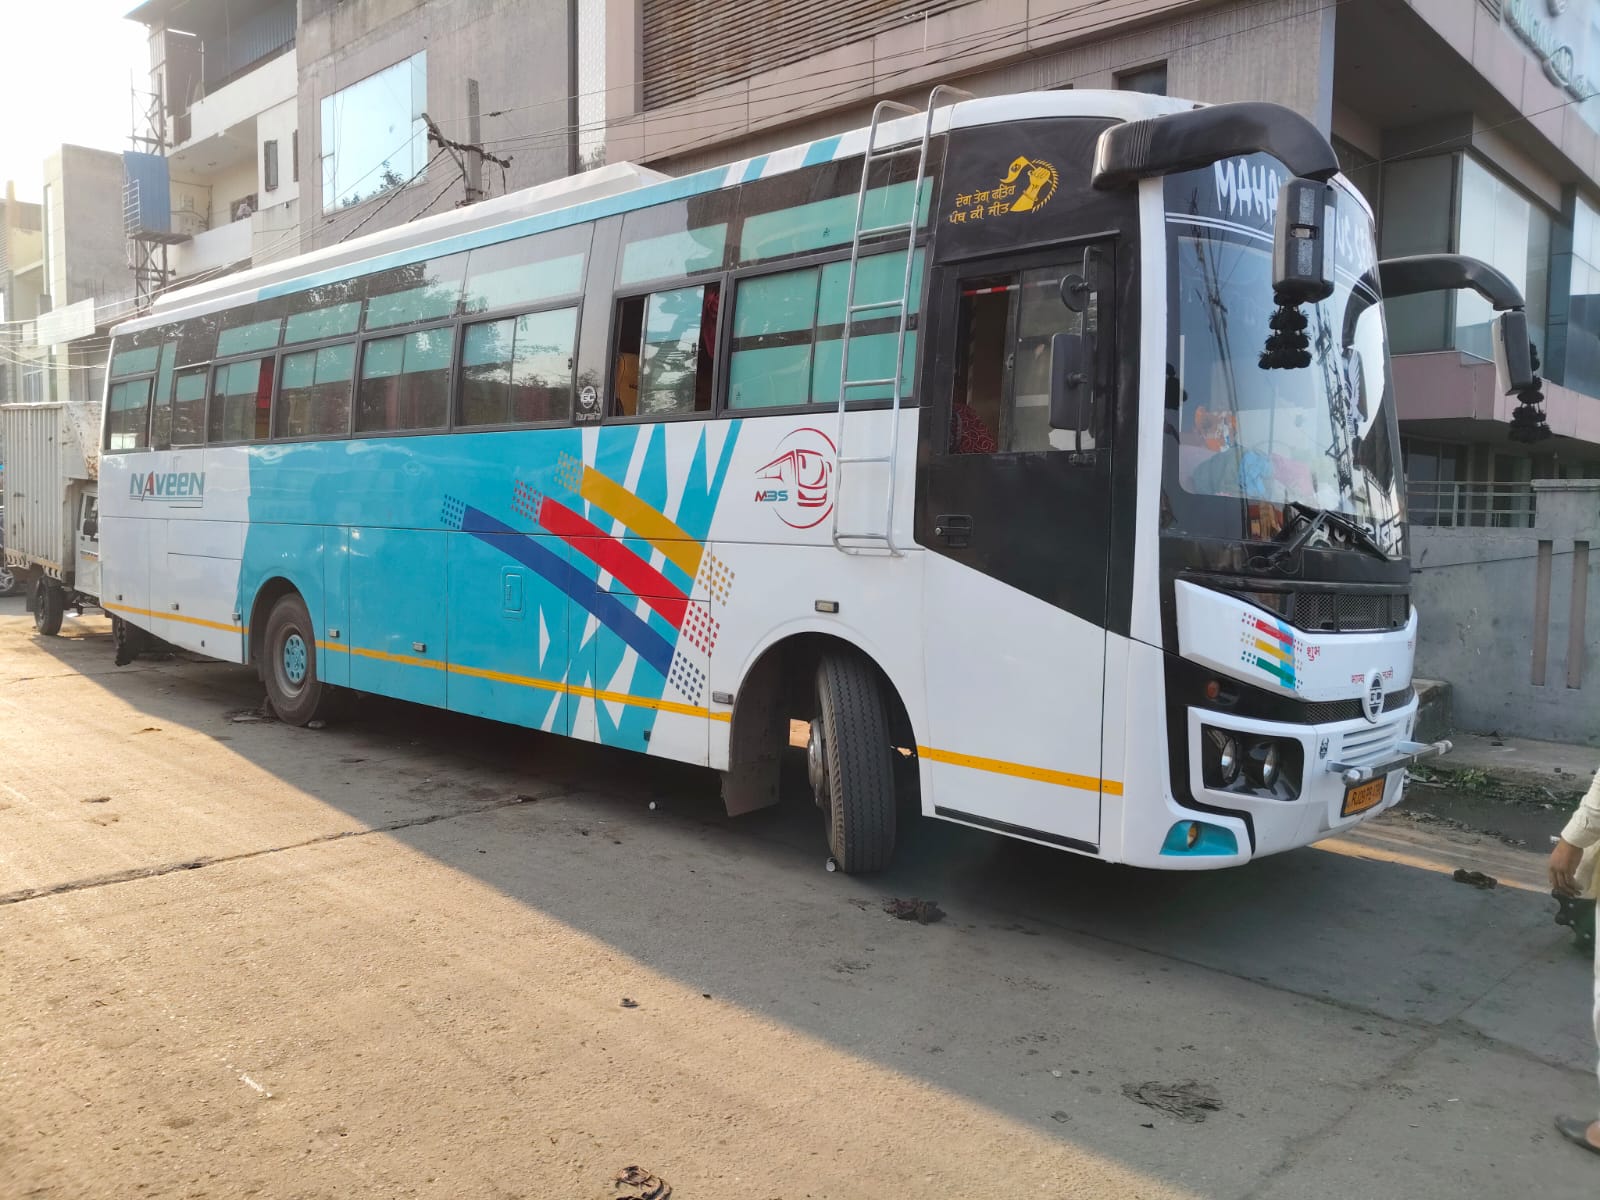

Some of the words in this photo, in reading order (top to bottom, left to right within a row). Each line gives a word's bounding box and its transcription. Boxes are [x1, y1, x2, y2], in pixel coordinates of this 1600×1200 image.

[970, 205, 984, 219] ਕੀ
[988, 202, 1010, 216] ਜੀਤ
[755, 490, 788, 502] MBS
[1306, 645, 1320, 661] शुभ
